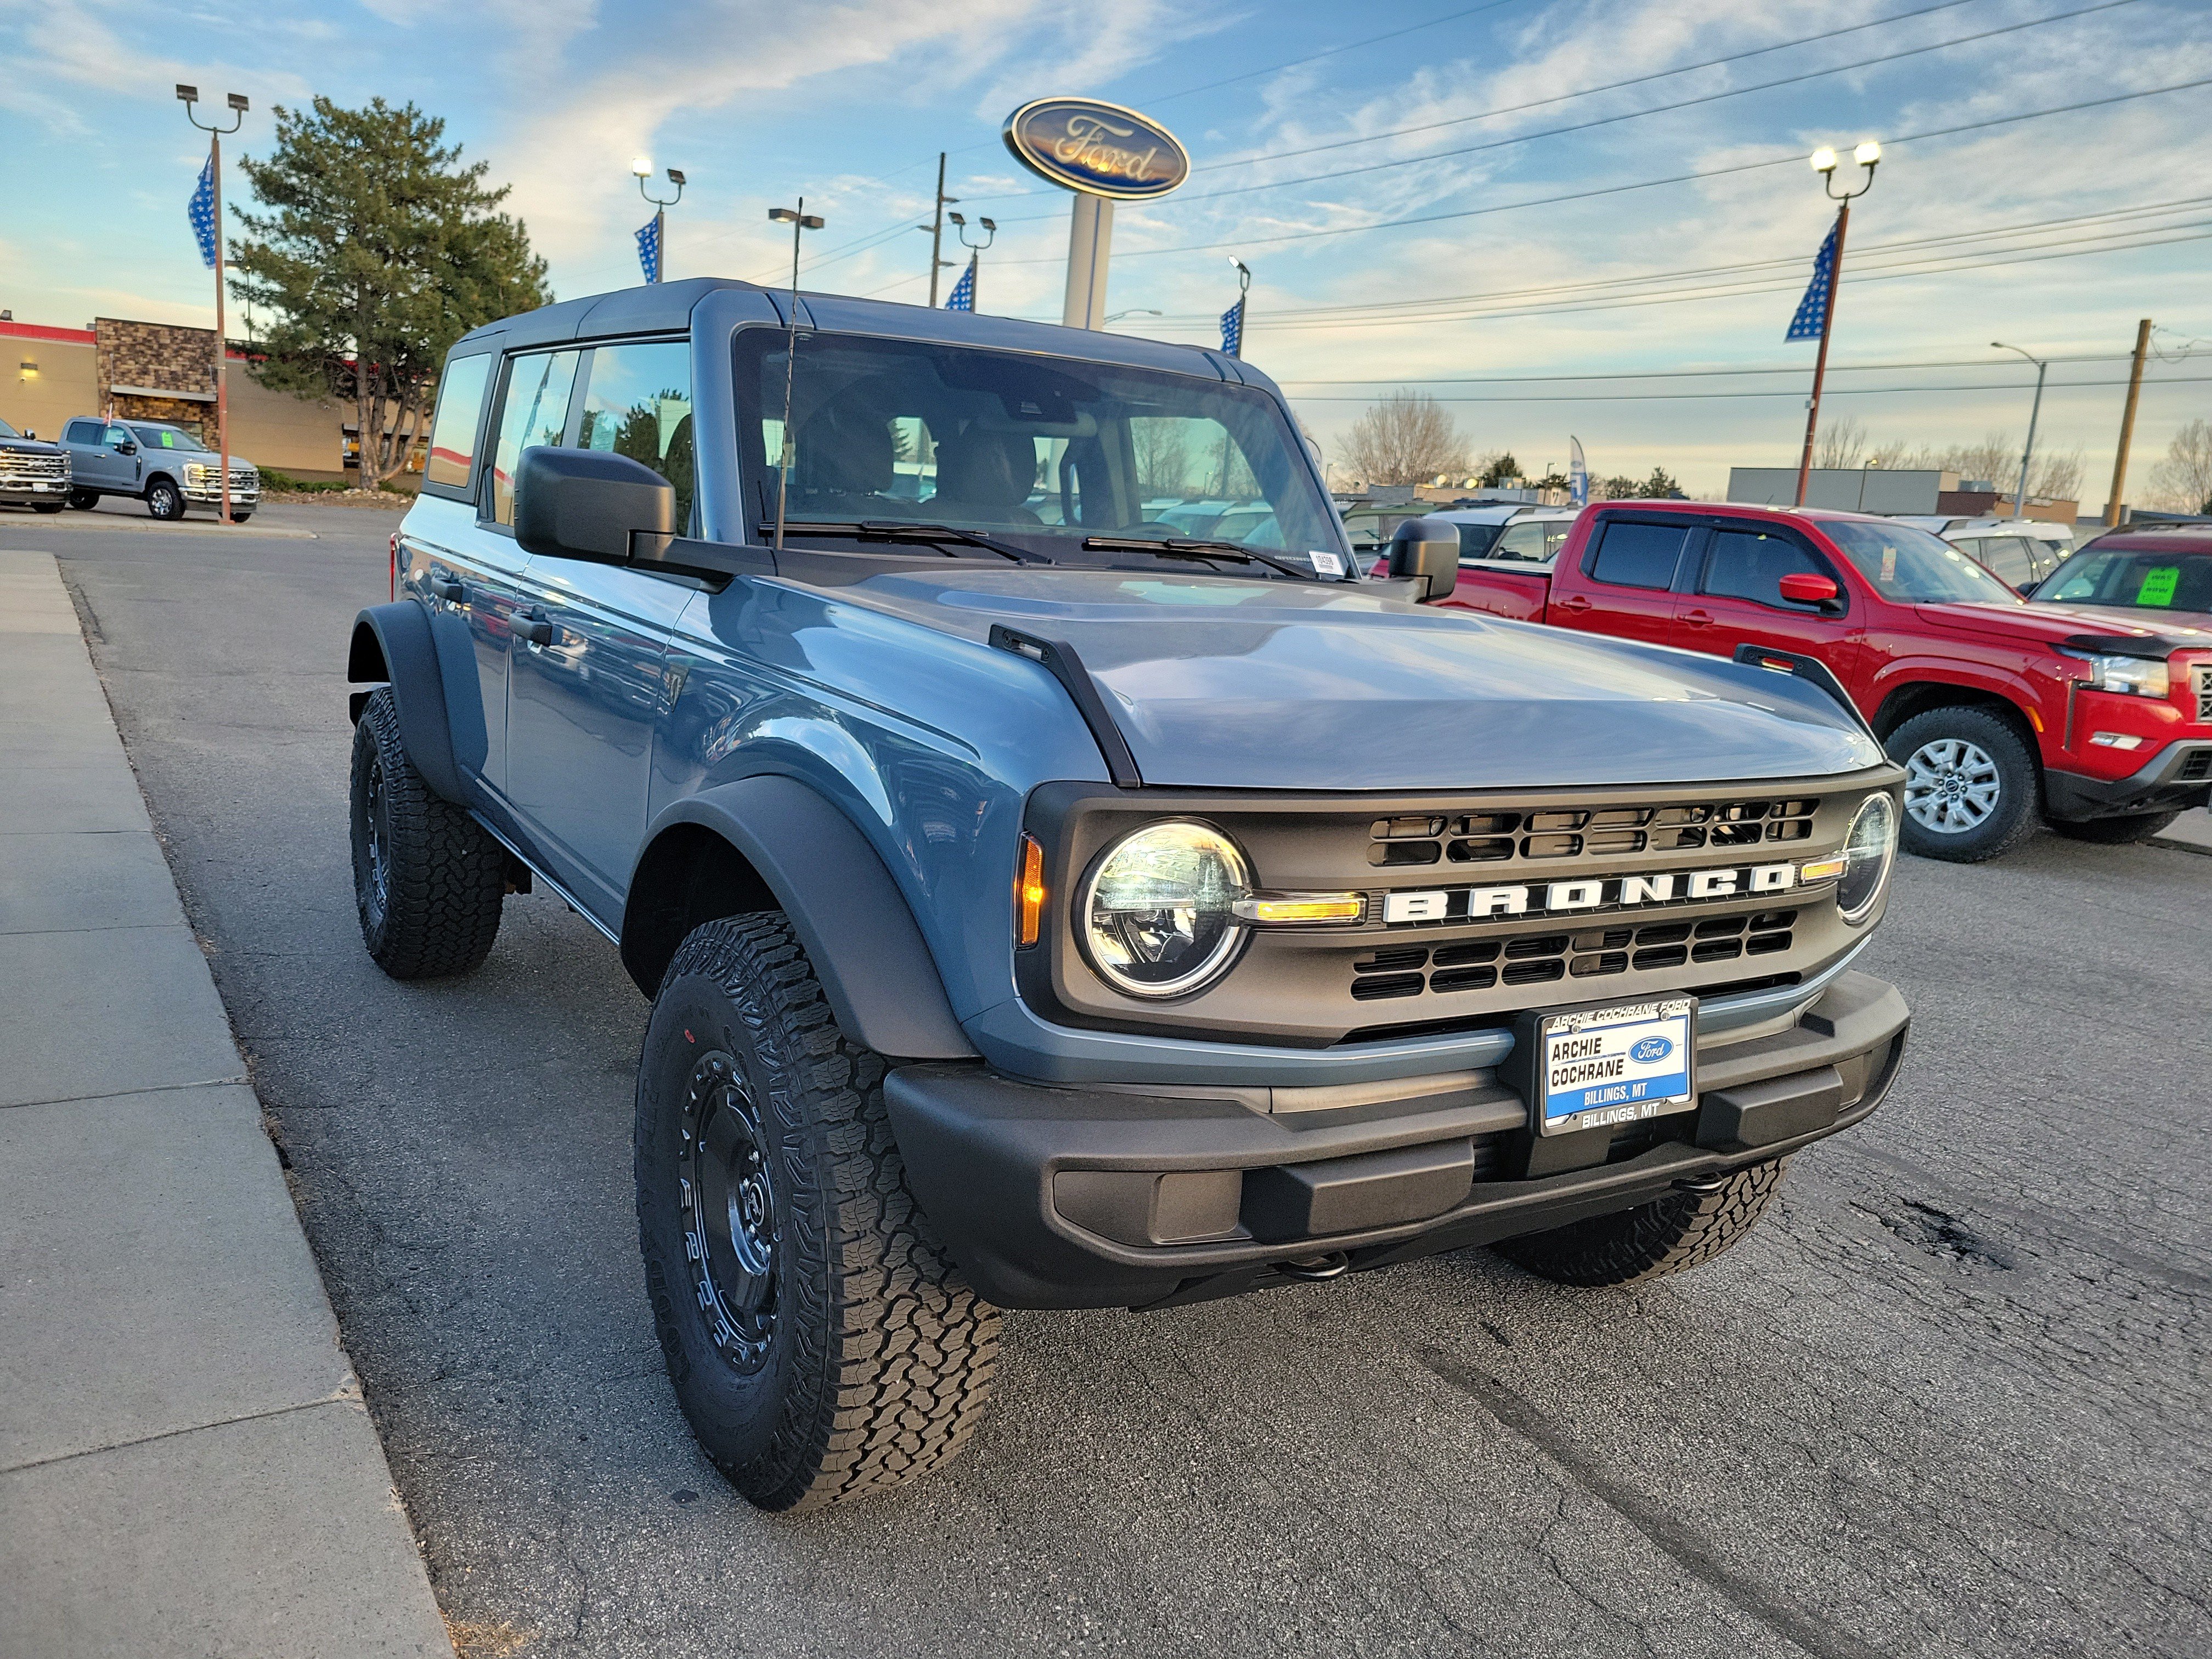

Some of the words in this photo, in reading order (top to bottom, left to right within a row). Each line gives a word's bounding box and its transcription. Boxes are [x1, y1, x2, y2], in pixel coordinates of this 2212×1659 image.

[1054, 115, 1157, 181] Ford
[1383, 864, 1795, 923] BRONCO
[1551, 1014, 1595, 1029] ARCHIE
[1596, 1003, 1658, 1022] COCHRANE
[1659, 999, 1691, 1013] FORD
[1552, 1037, 1602, 1062] ARCHIE
[1638, 1040, 1664, 1059] Ford
[1552, 1058, 1624, 1087] COCHRANE
[1584, 1086, 1629, 1106] BILLINGS,
[1632, 1082, 1647, 1098] MT
[1582, 1107, 1637, 1128] BILLINGS,
[1640, 1102, 1660, 1118] MT
